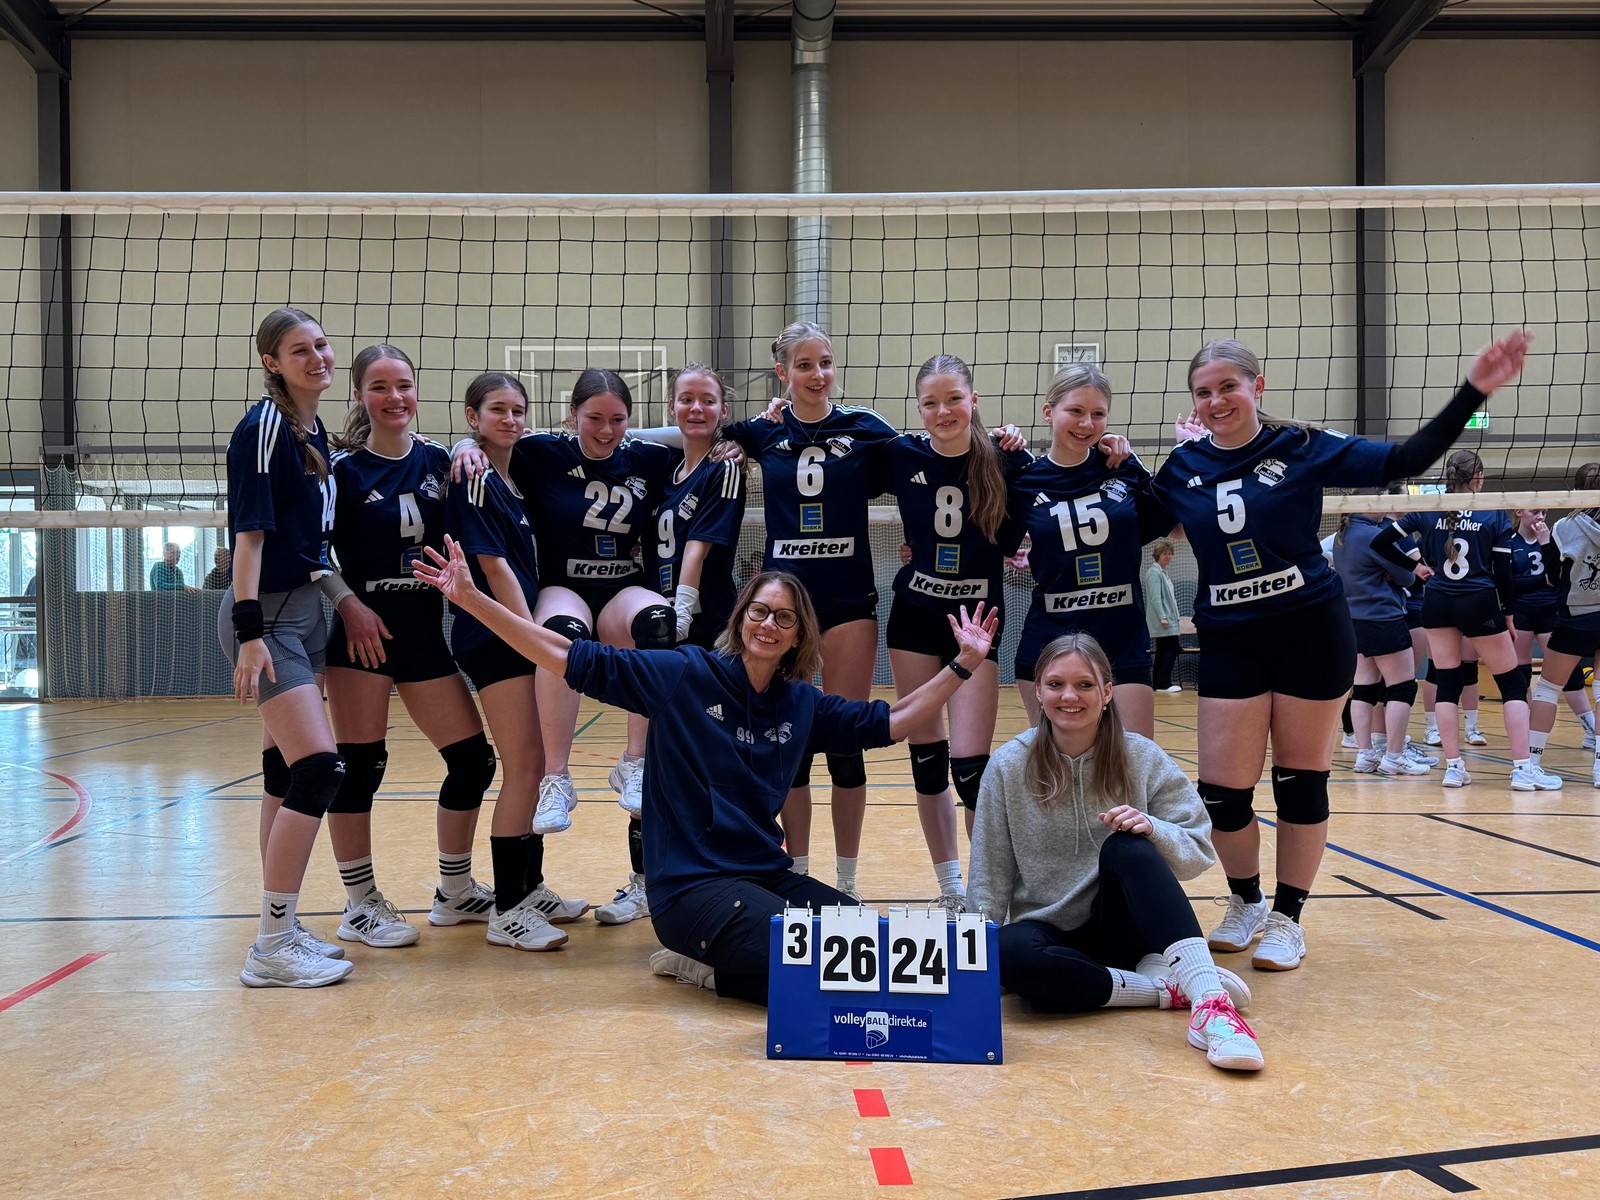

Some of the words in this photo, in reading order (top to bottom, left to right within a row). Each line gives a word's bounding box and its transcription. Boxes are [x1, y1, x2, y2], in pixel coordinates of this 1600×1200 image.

[797, 446, 826, 497] 6
[399, 492, 425, 544] 4
[583, 481, 633, 534] 22
[934, 485, 963, 538] 8
[1049, 492, 1110, 551] 15
[1216, 479, 1246, 534] 5
[1435, 518, 1482, 531] Alr-Oker
[657, 509, 676, 559] 9
[779, 541, 849, 555] Kreiter
[1443, 538, 1470, 581] 8
[1528, 551, 1545, 576] 3
[913, 576, 982, 597] Kreiter
[1052, 590, 1127, 610] Kreiter
[1215, 573, 1296, 603] Kreiter
[705, 708, 725, 721] adidas
[736, 726, 755, 745] 99
[787, 922, 808, 959] 3
[822, 935, 877, 983] 26
[891, 937, 946, 985] 24
[961, 929, 977, 965] 1
